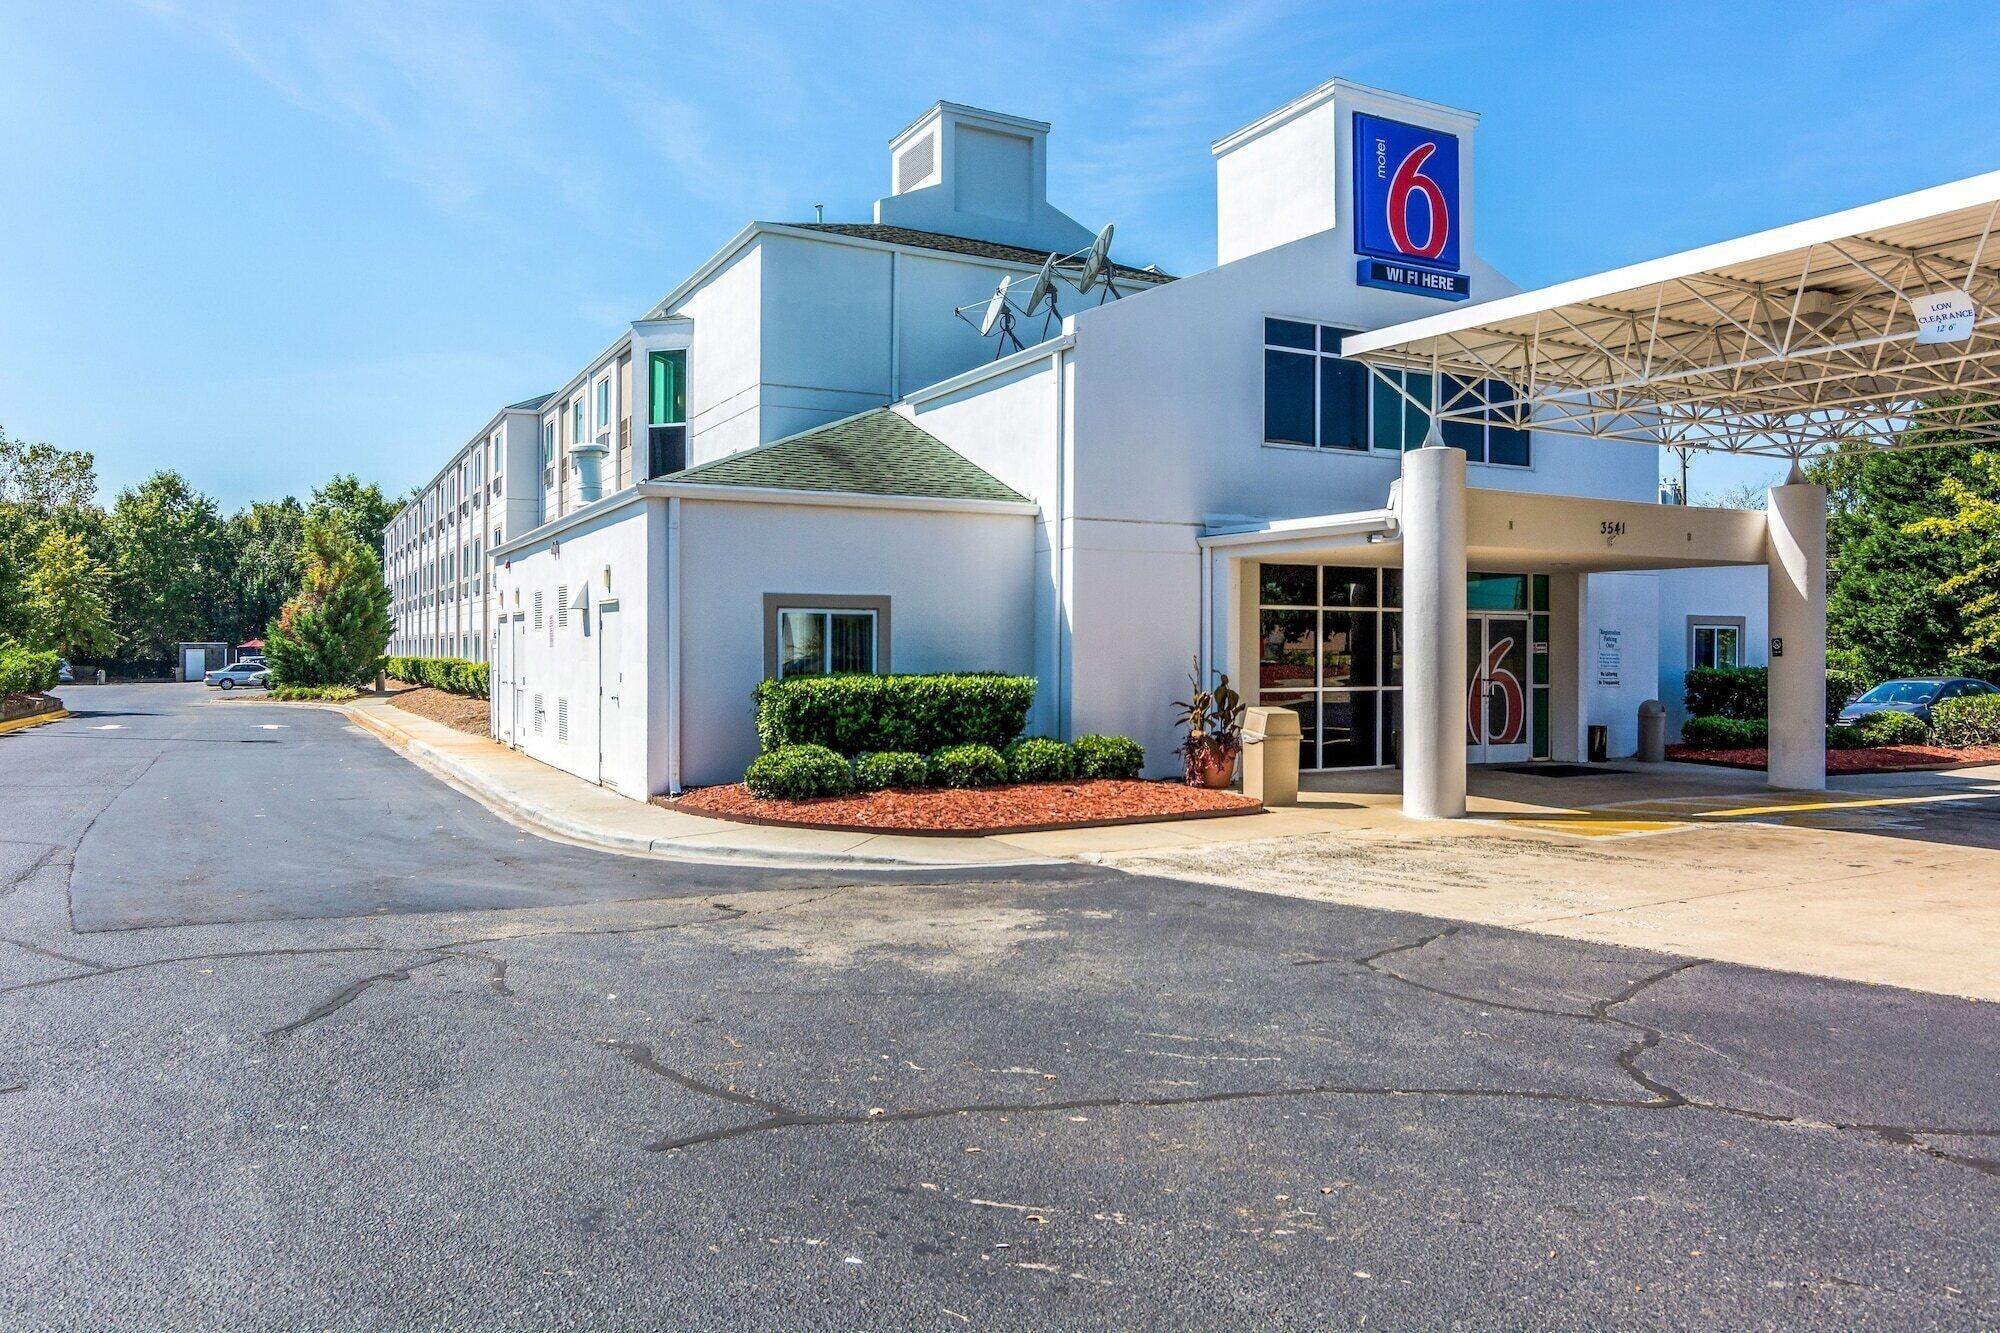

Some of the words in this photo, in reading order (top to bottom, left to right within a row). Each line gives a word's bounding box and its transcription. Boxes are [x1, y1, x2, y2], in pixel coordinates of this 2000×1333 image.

[1375, 138, 1386, 179] motel
[1386, 142, 1449, 259] 6
[1386, 266, 1403, 283] WI
[1407, 270, 1419, 285] FI
[1422, 273, 1454, 291] HERE
[1918, 309, 1974, 324] CLEARANCE
[1931, 302, 1952, 312] LOW
[1600, 521, 1625, 535] 3541
[1468, 637, 1524, 744] 6
